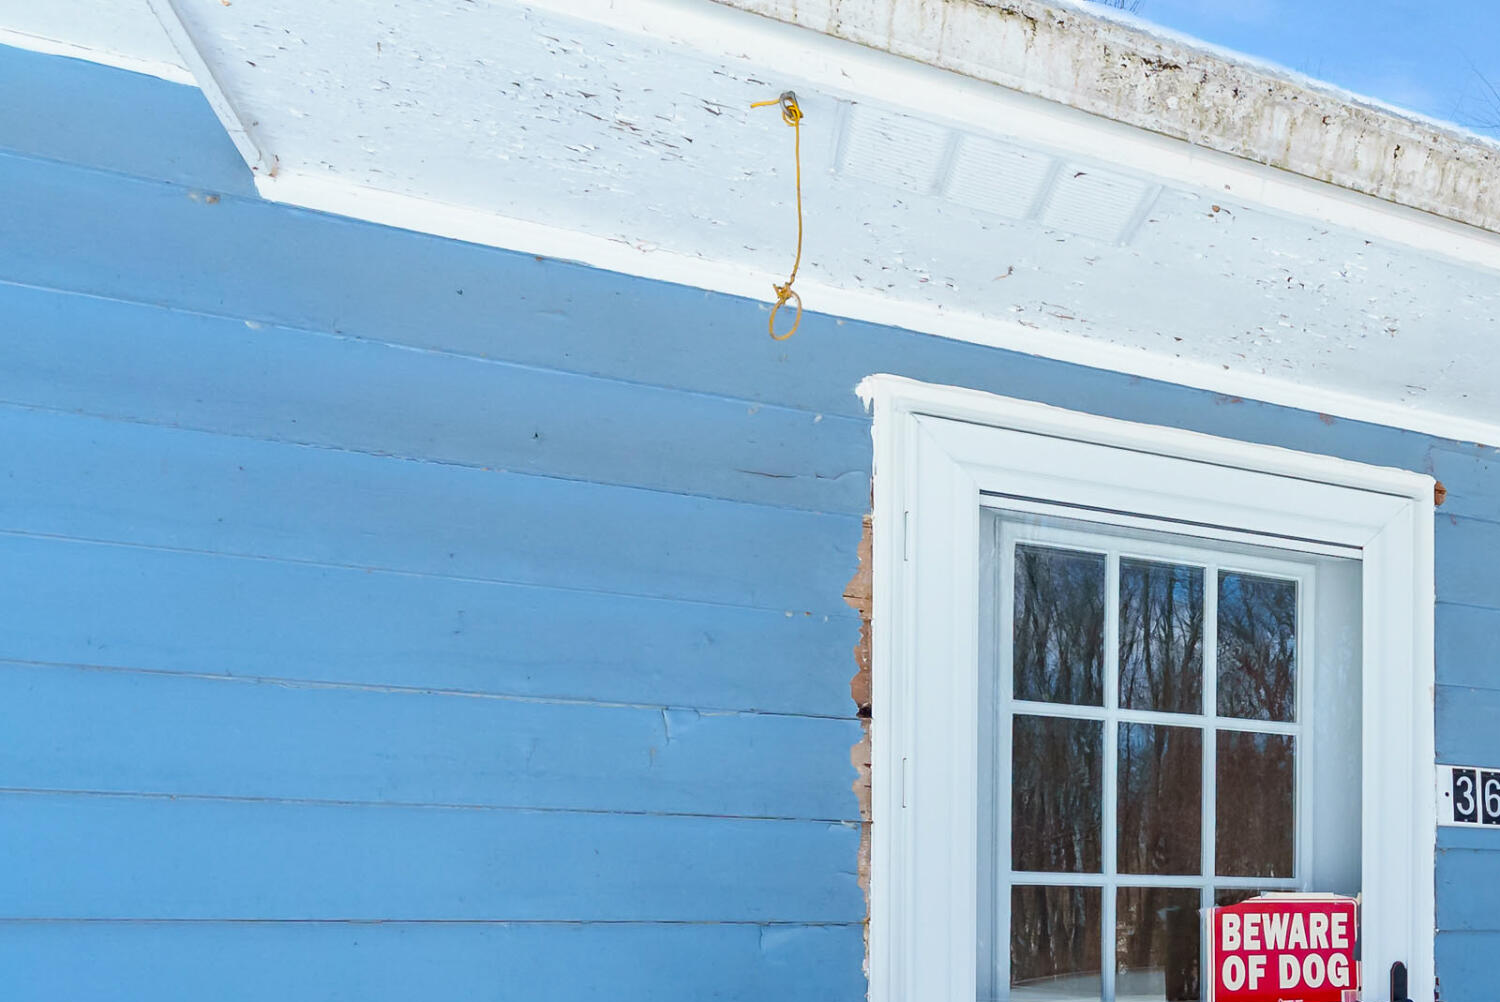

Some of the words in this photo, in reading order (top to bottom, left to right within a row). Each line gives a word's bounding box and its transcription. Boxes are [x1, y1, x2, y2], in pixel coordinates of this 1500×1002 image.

[1221, 912, 1349, 952] BEWARE
[1221, 954, 1267, 992] OF
[1278, 952, 1350, 990] DOG
